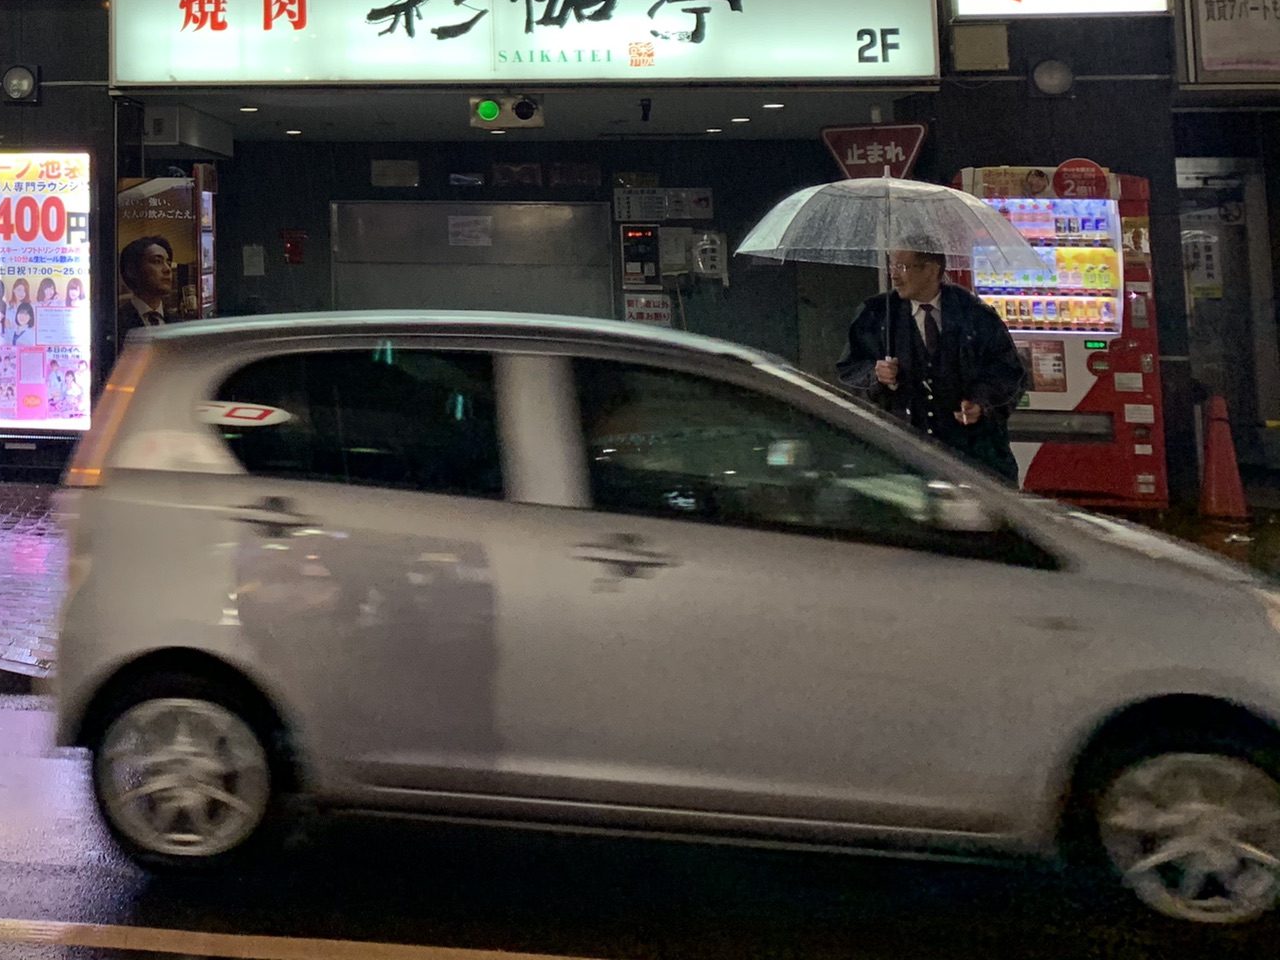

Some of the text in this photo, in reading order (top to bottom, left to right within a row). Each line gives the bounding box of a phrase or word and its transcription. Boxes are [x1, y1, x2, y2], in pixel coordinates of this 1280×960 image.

[498, 50, 612, 63] SAIKATEI
[857, 28, 900, 63] 2F
[845, 141, 906, 165] 止まれ
